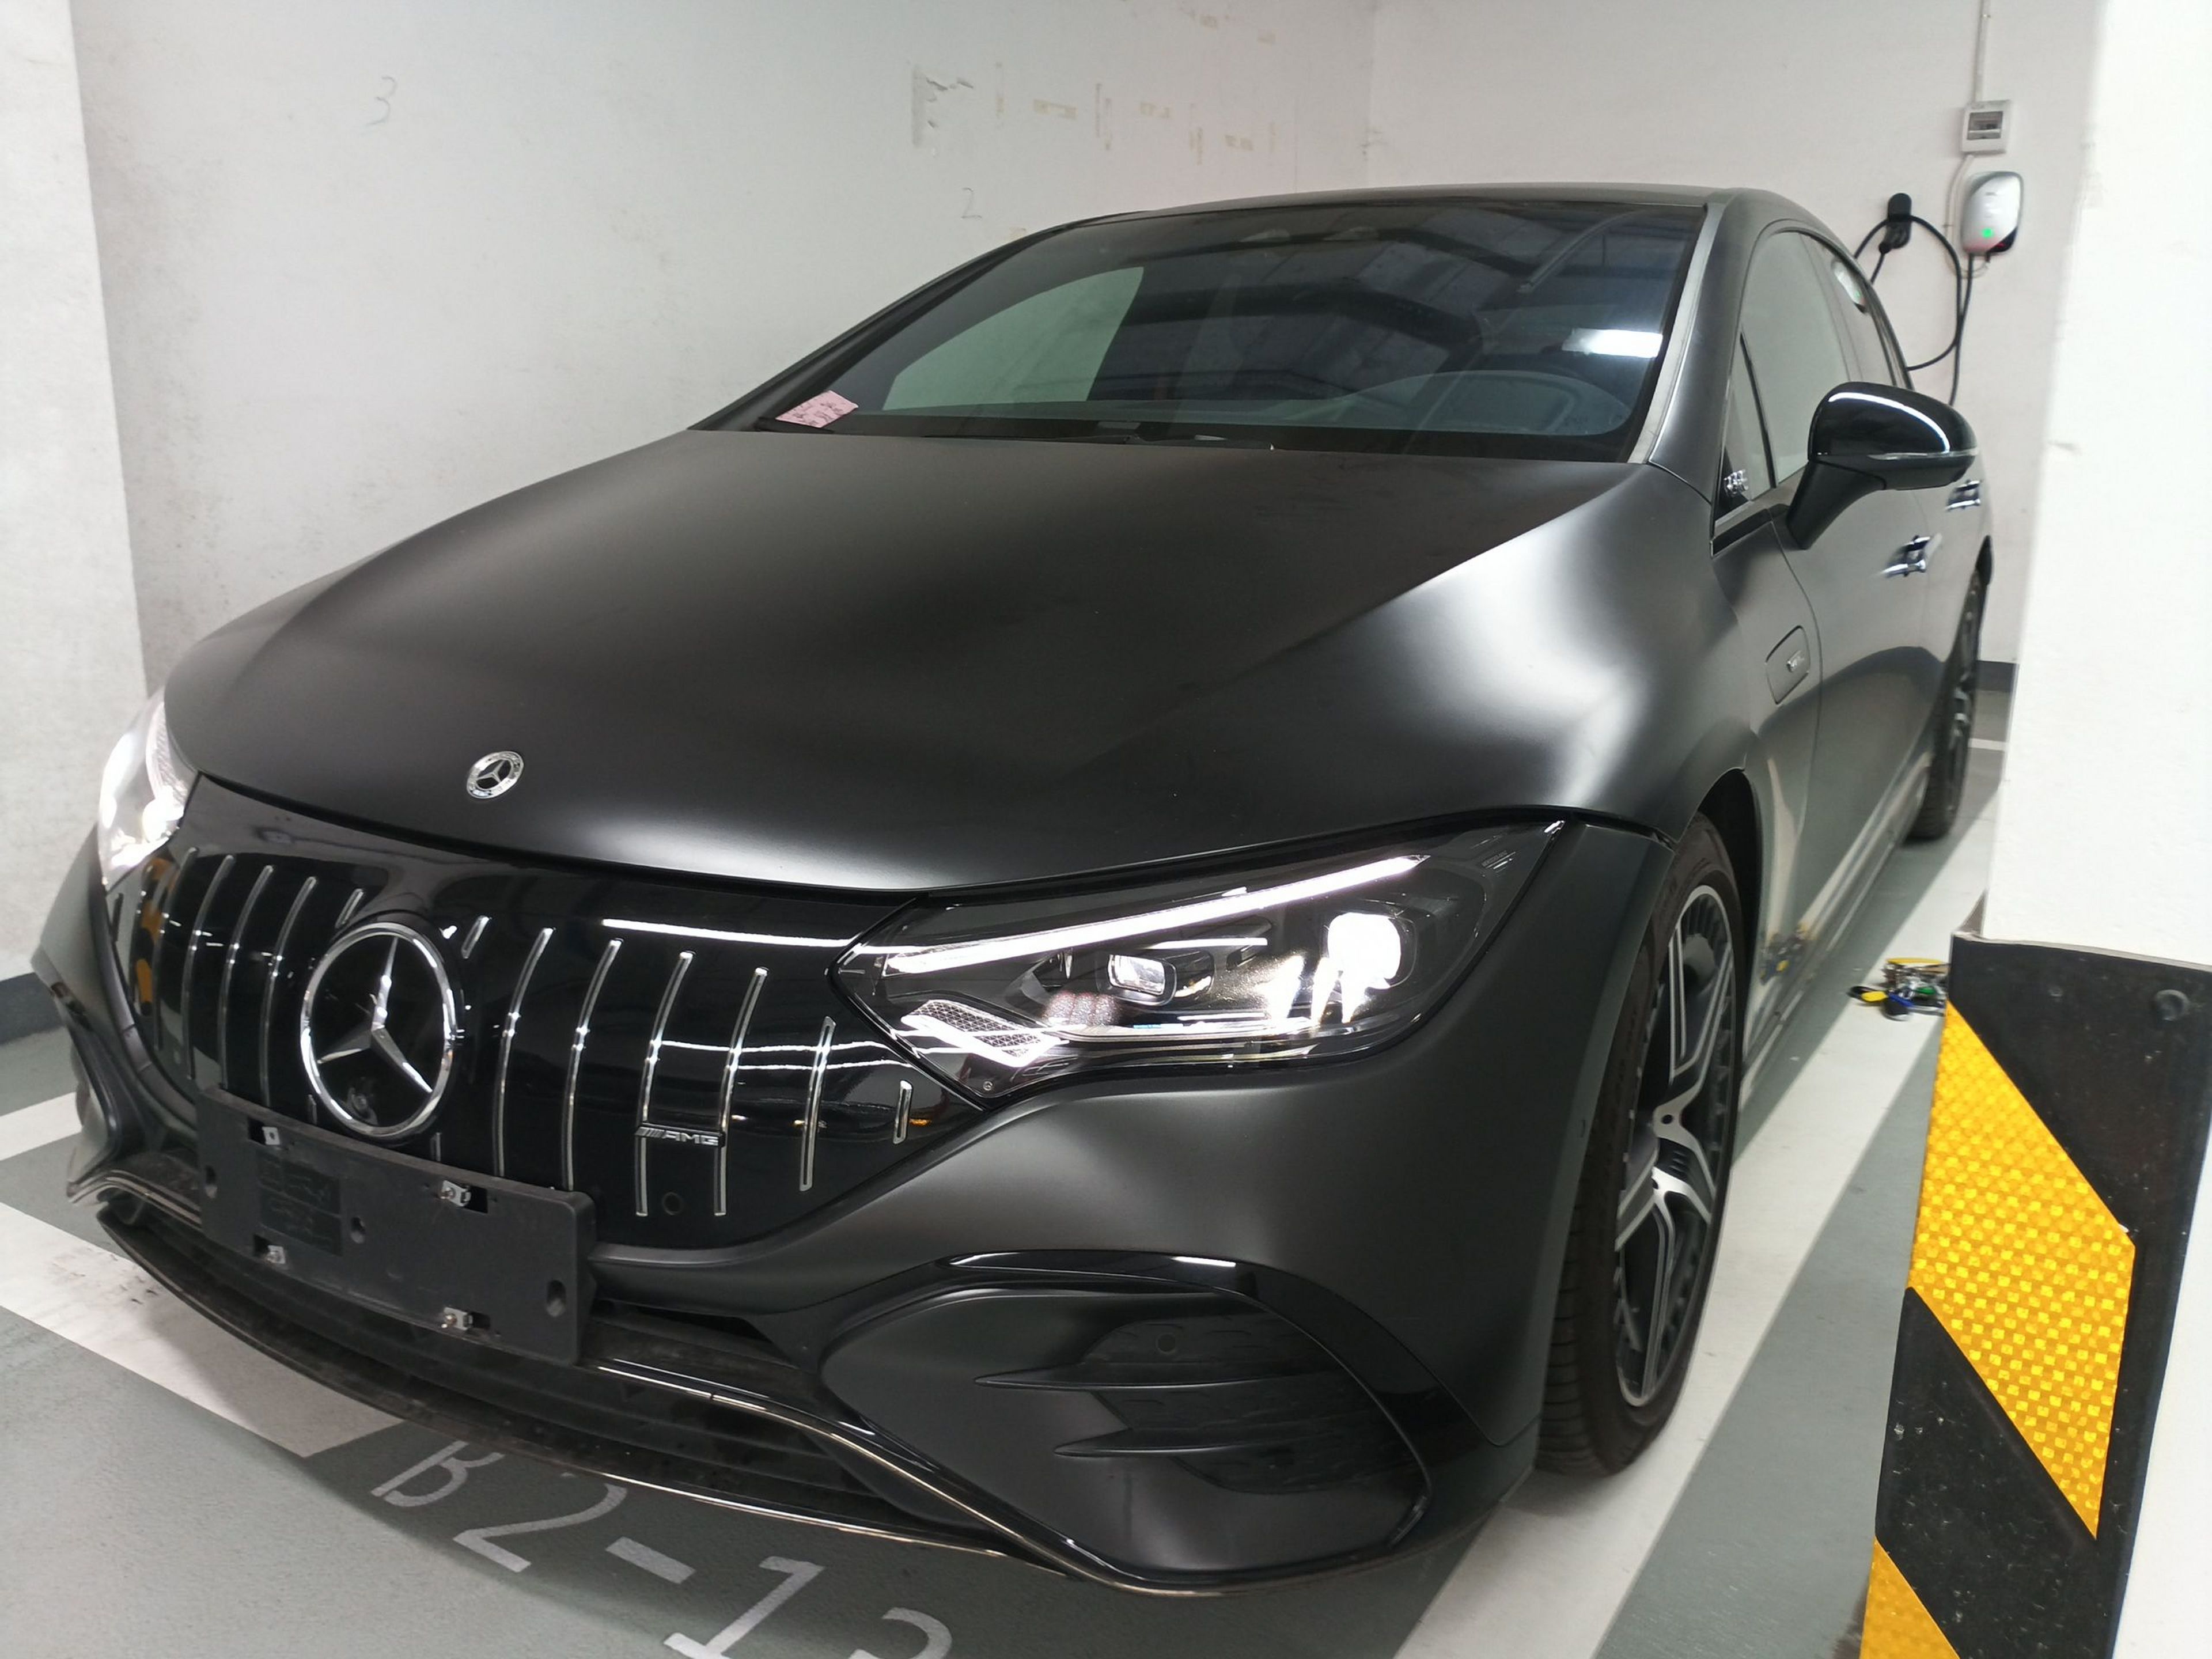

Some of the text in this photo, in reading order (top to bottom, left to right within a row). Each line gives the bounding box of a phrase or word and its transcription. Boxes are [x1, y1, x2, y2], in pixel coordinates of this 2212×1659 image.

[365, 75, 397, 126] 3
[961, 187, 982, 218] 2
[662, 1130, 719, 1146] AMG
